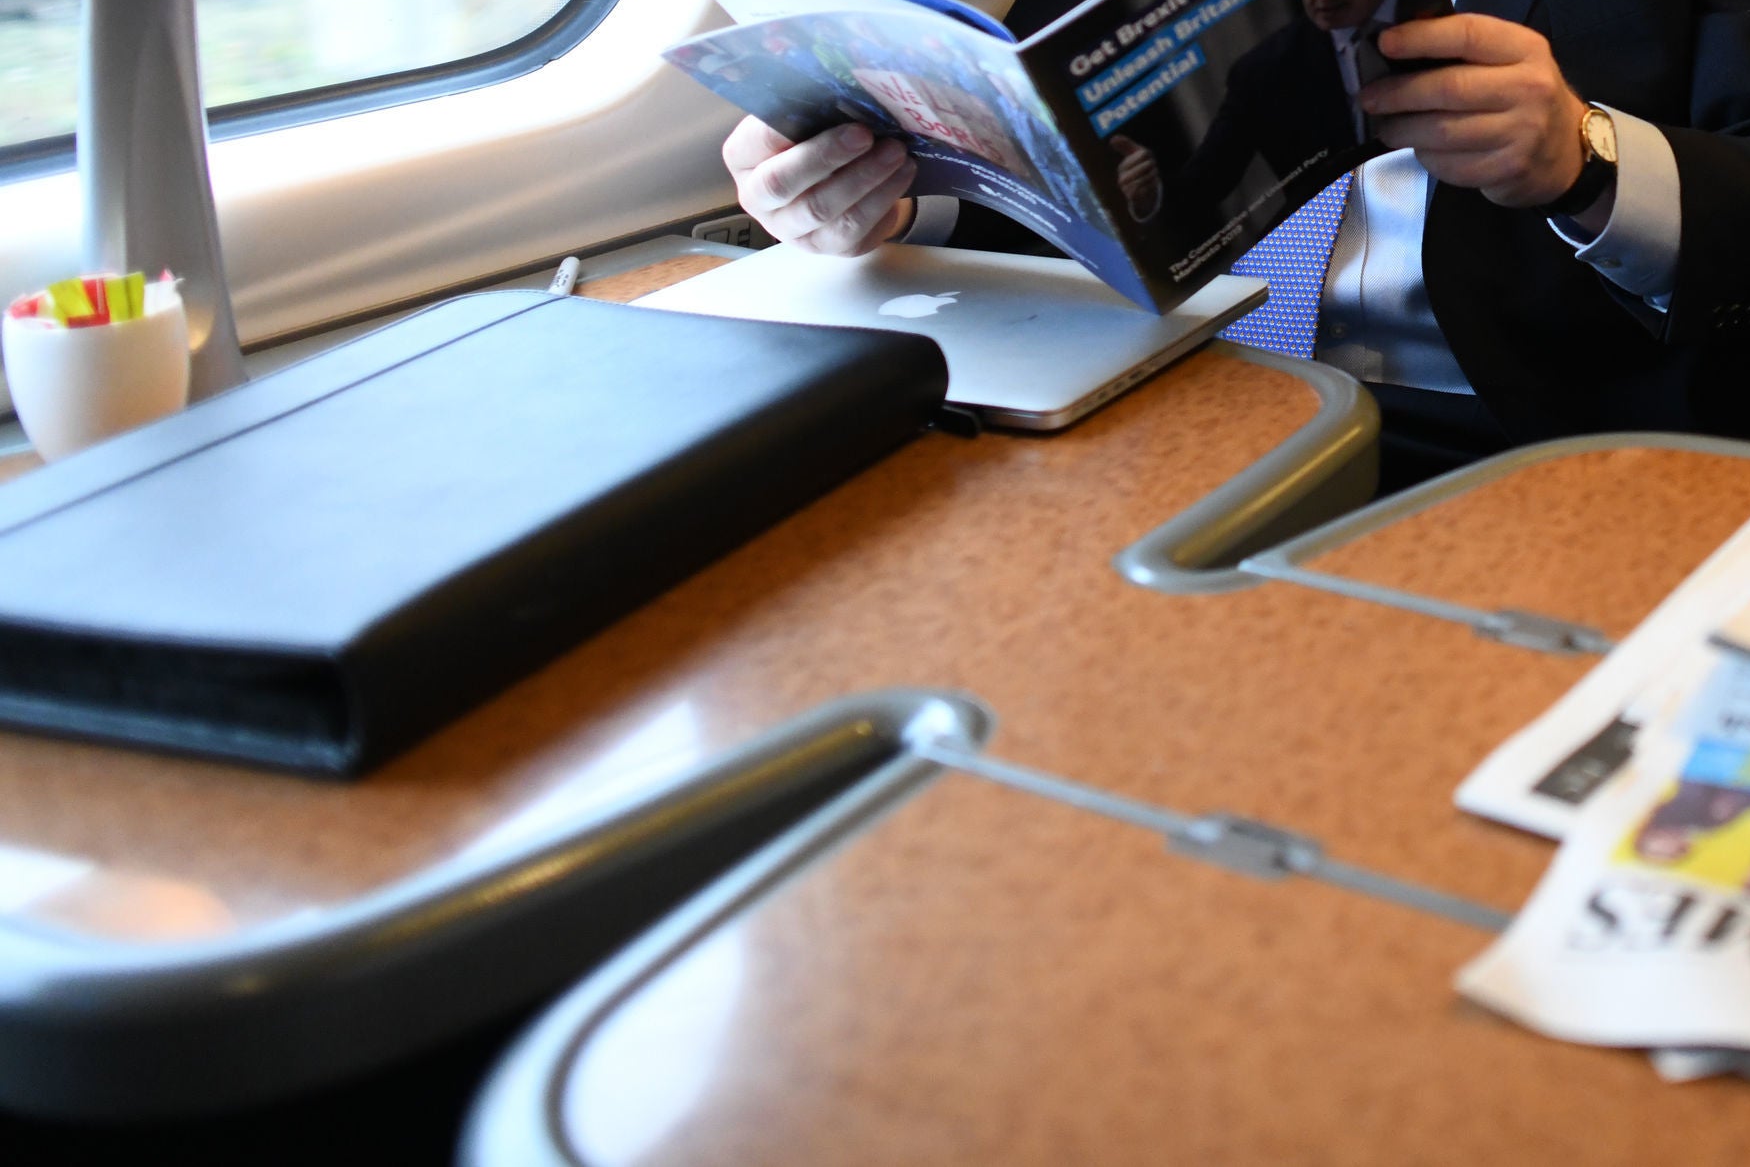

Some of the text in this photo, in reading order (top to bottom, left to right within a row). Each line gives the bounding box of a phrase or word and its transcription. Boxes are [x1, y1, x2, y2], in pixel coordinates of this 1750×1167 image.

[1069, 39, 1117, 76] Get
[1082, 35, 1174, 103] Unleash
[1096, 49, 1199, 130] Potential
[1168, 258, 1189, 274] The
